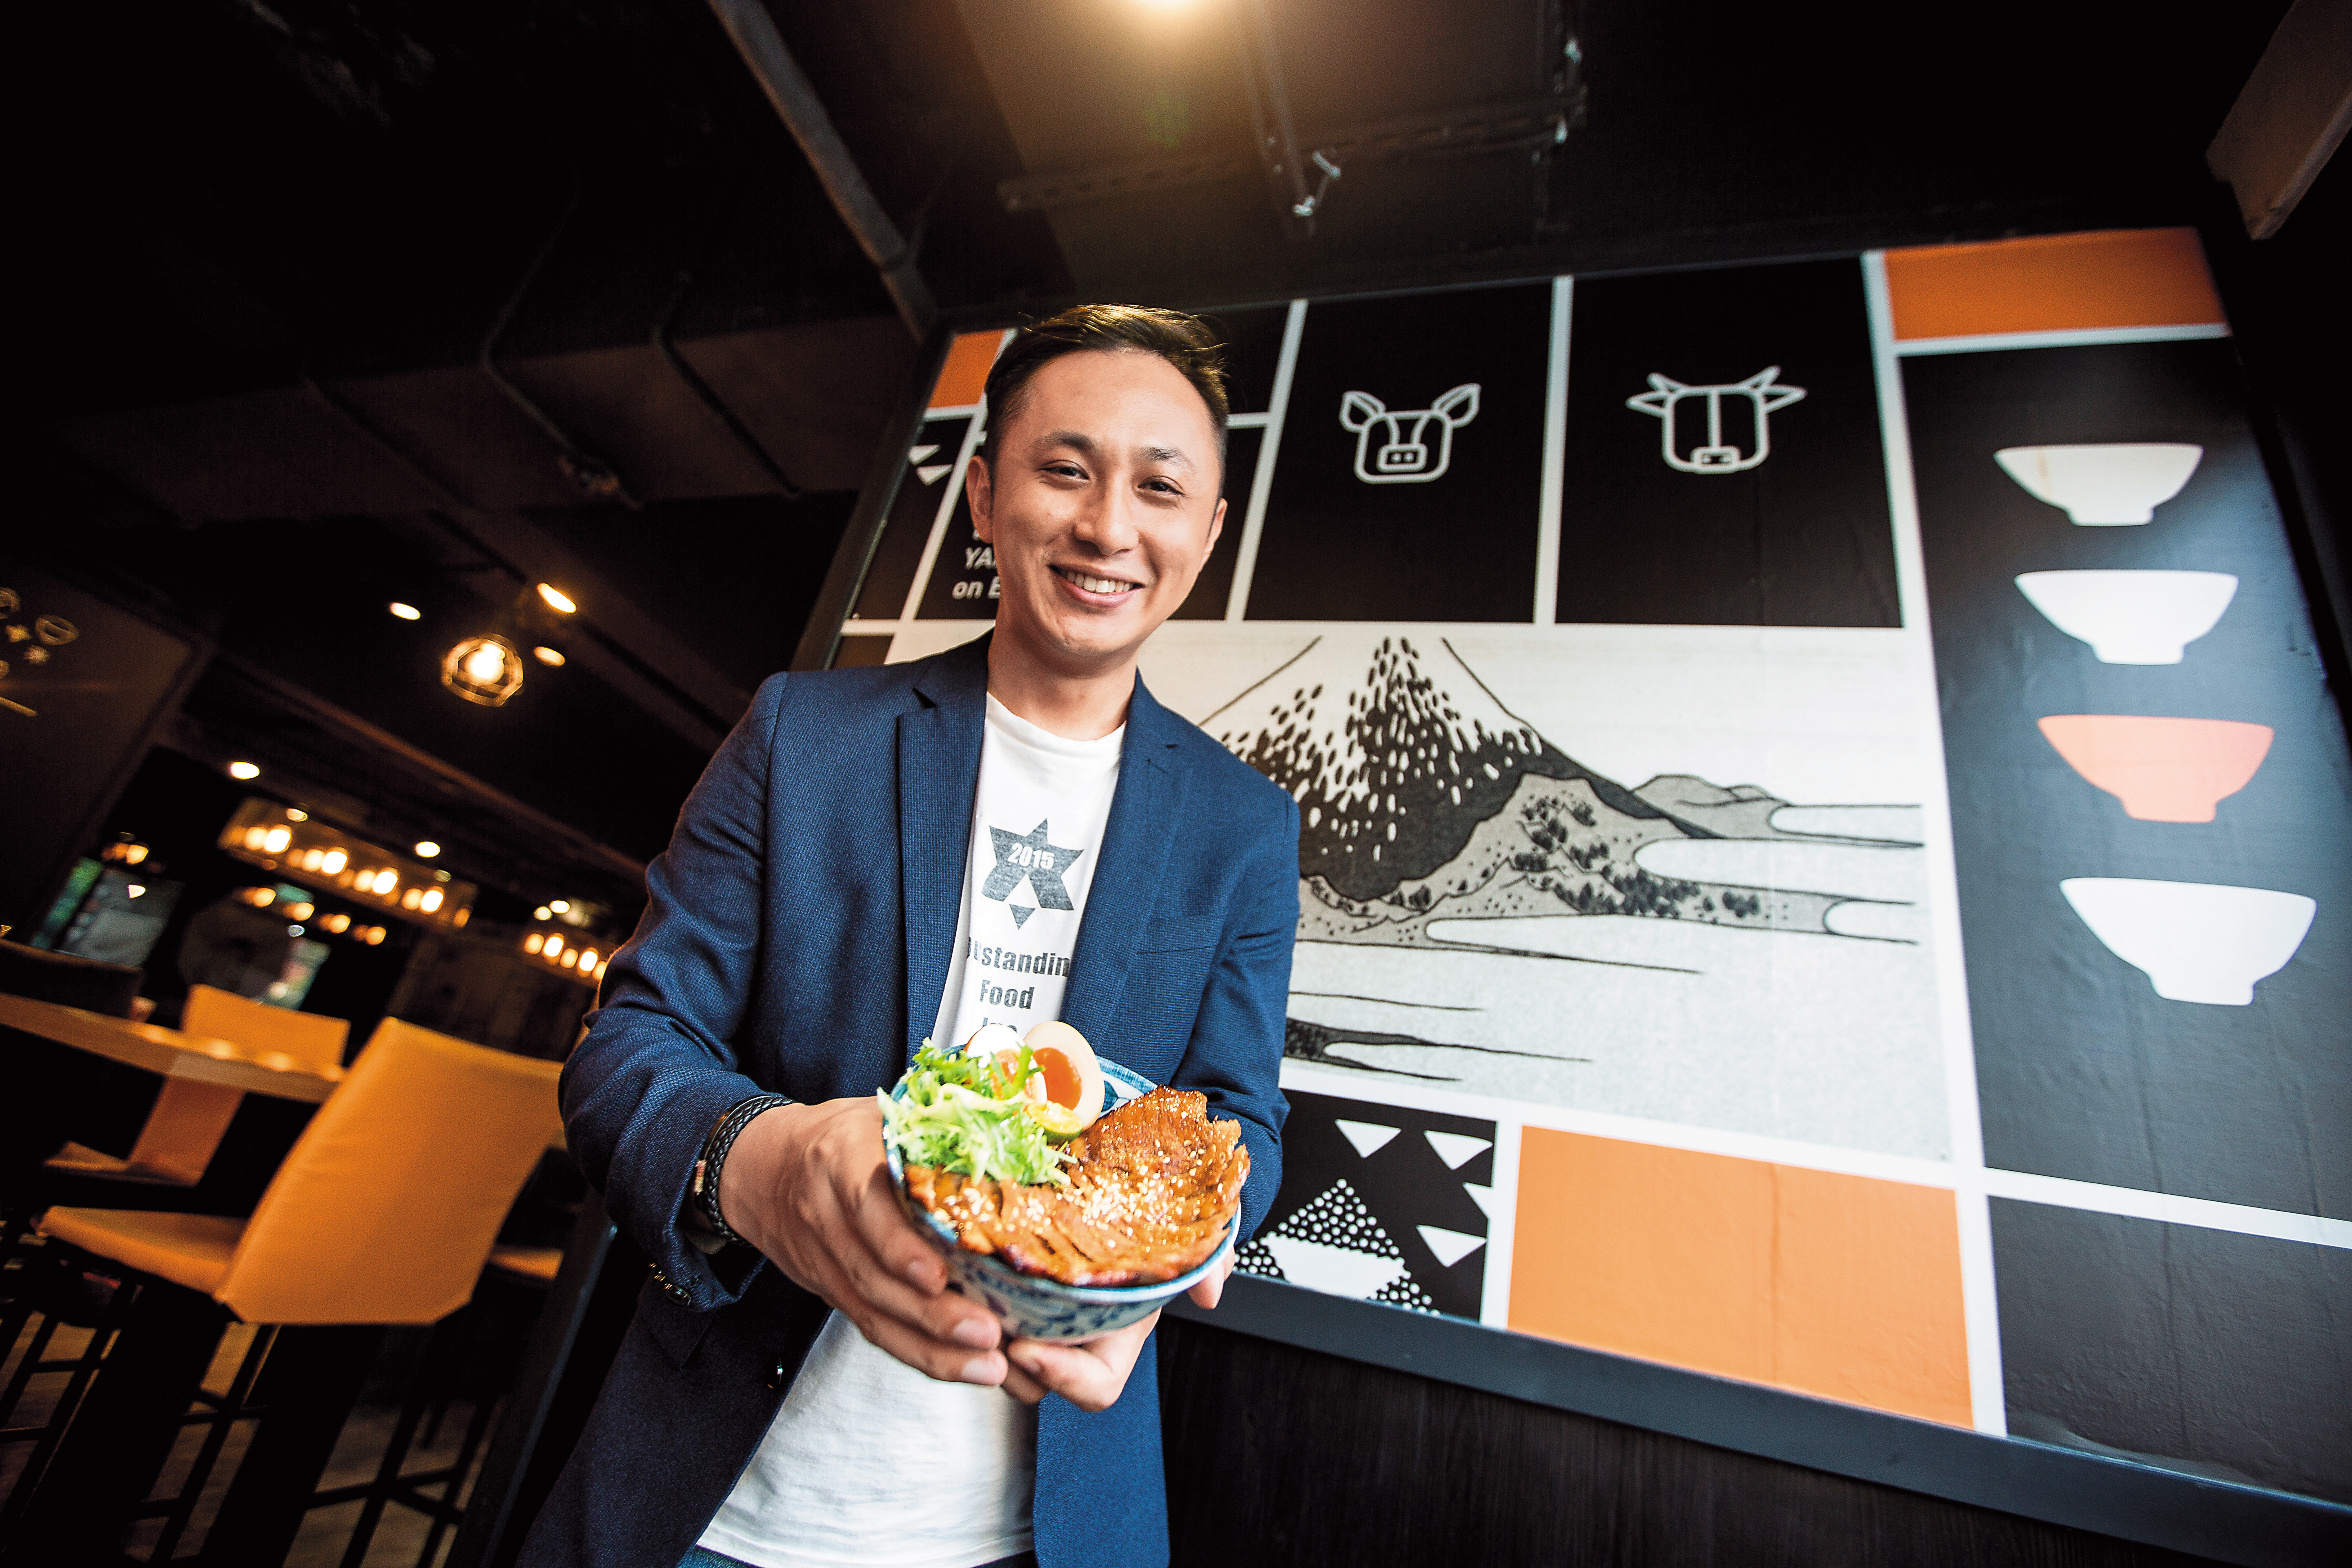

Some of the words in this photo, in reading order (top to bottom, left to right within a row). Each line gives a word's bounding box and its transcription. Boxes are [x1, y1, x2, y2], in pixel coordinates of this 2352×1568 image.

[952, 581, 984, 600] on
[1007, 842, 1055, 870] 2015
[980, 980, 1035, 1009] Food
